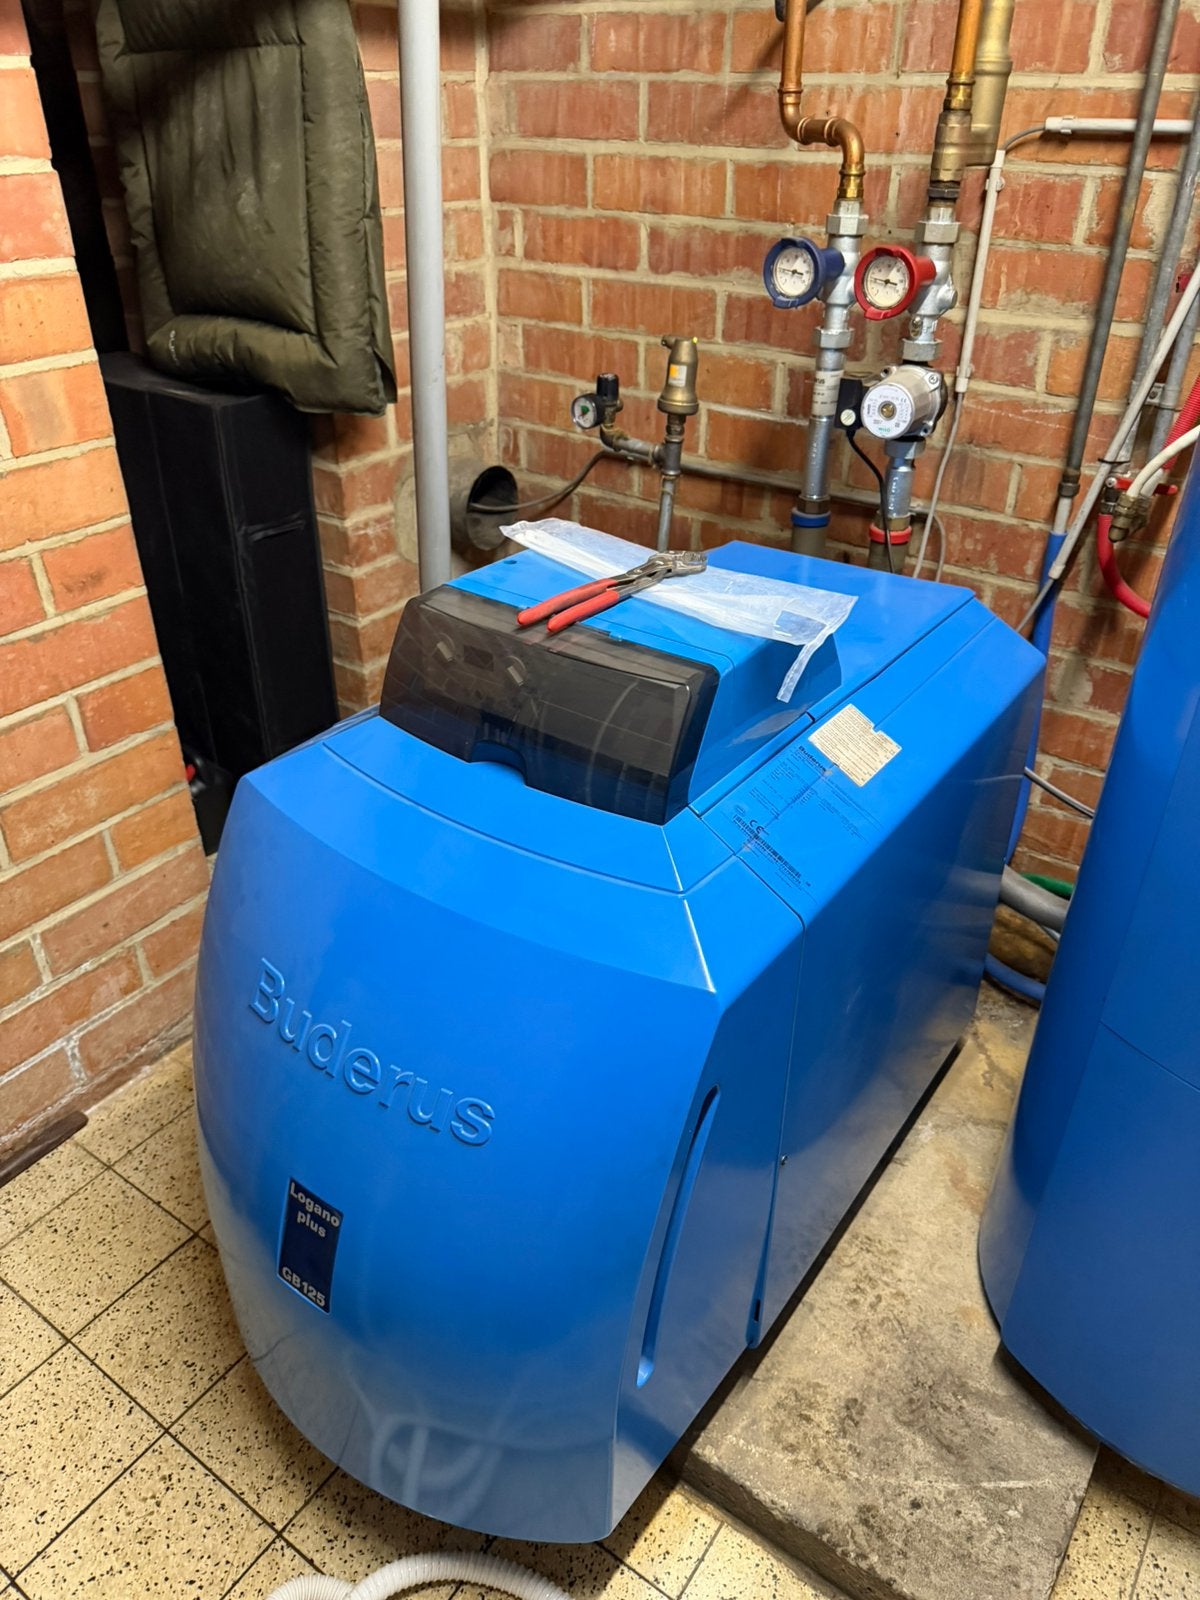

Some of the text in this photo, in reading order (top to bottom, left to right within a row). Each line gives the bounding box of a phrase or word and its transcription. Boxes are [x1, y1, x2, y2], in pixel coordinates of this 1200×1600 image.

[798, 745, 826, 772] Buderus
[249, 957, 496, 1147] Buderus
[290, 1181, 340, 1228] Logano
[297, 1210, 326, 1237] plus
[282, 1266, 326, 1308] GB125
